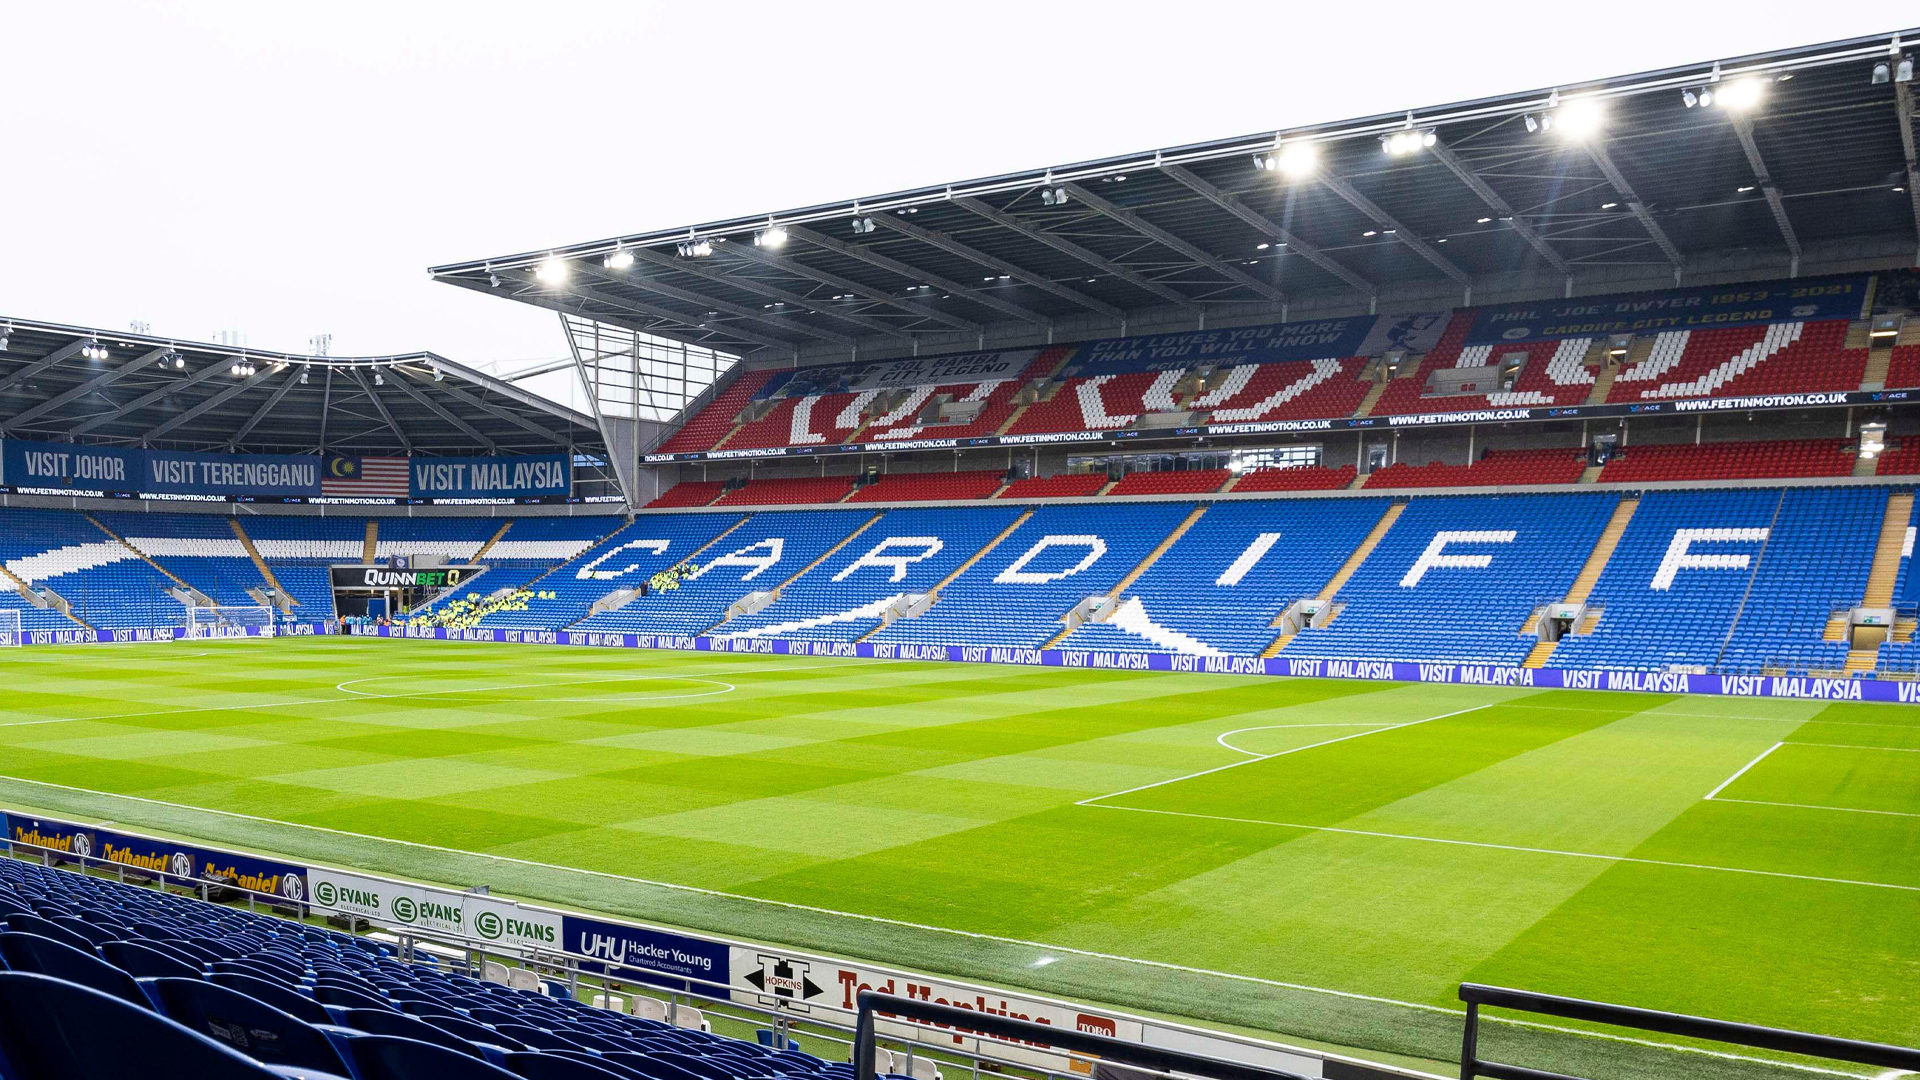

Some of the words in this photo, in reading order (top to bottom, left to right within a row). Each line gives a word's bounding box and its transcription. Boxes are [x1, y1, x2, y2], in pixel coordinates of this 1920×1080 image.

[1093, 338, 1145, 352] CITY
[1145, 332, 1221, 348] LOVES
[1229, 326, 1274, 342] YOU
[1279, 320, 1350, 337] MORE
[1087, 349, 1143, 363] THAN
[1150, 345, 1193, 359] YOU
[1199, 337, 1256, 354] WILL
[879, 368, 927, 382] CITY
[928, 362, 1011, 378] LEGEND
[1675, 393, 1847, 411] WWW.FEETINMOTION.CO.UK
[1388, 409, 1530, 425] WWW.FEETINMOTION.CO.UK
[1208, 420, 1331, 434] WWW.FEETINMOTION.CO.UK
[865, 439, 957, 451] WWW.FEETINMOTION.CO.UK
[999, 431, 1104, 444] WWW.FEETINMOTION.CO.UK
[25, 451, 70, 477] VISIT
[73, 455, 125, 481] JOHOR
[152, 459, 196, 484] VISIT
[200, 462, 315, 487] TERENGGANU
[416, 464, 466, 490] VISIT
[470, 461, 565, 490] MALAYSIA
[30, 632, 52, 644] VISIT
[56, 630, 98, 643] MALAYSIA
[112, 630, 132, 642] VISIT
[388, 624, 404, 637] VISIT
[446, 628, 462, 639] VISIT
[464, 628, 494, 641] MALAYSIA
[505, 631, 522, 642] VISIT
[524, 632, 556, 644] MALAYSIA
[568, 632, 586, 644] VISIT
[636, 636, 656, 648] VISIT
[658, 636, 696, 650] MALAYSIA
[710, 638, 730, 650] VISIT
[732, 639, 773, 653] MALAYSIA
[788, 641, 810, 654] VISIT
[812, 642, 856, 656] MALAYSIA
[873, 644, 897, 658] VISIT
[900, 645, 946, 660] MALAYSIA
[962, 647, 988, 662] VISIT
[990, 648, 1042, 664] MALAYSIA
[1062, 651, 1090, 666] VISIT
[1093, 652, 1150, 670] MALAYSIA
[1170, 654, 1201, 672] VISIT
[1204, 656, 1266, 674] MALAYSIA
[1289, 660, 1322, 676] VISIT
[1326, 660, 1394, 680] MALAYSIA
[1419, 664, 1456, 682] VISIT
[1460, 666, 1534, 686] MALAYSIA
[1562, 670, 1602, 688] VISIT
[1607, 672, 1689, 693] MALAYSIA
[1721, 675, 1766, 696] VISIT
[1771, 677, 1862, 700] MALAYSIA
[16, 826, 70, 852] Nathaniel
[103, 844, 168, 875] Nathaniel
[340, 887, 380, 908] EVANS
[340, 904, 370, 916] ELECTRICAL
[420, 902, 462, 924] EVANS
[506, 918, 555, 942] EVANS
[580, 932, 627, 970] UHY
[628, 940, 670, 960] Hacker
[671, 948, 712, 970] Young
[628, 955, 656, 967] Chartered
[656, 960, 692, 974] Accountants
[765, 976, 802, 991] HOPKINS
[1078, 1022, 1112, 1037] TORO
